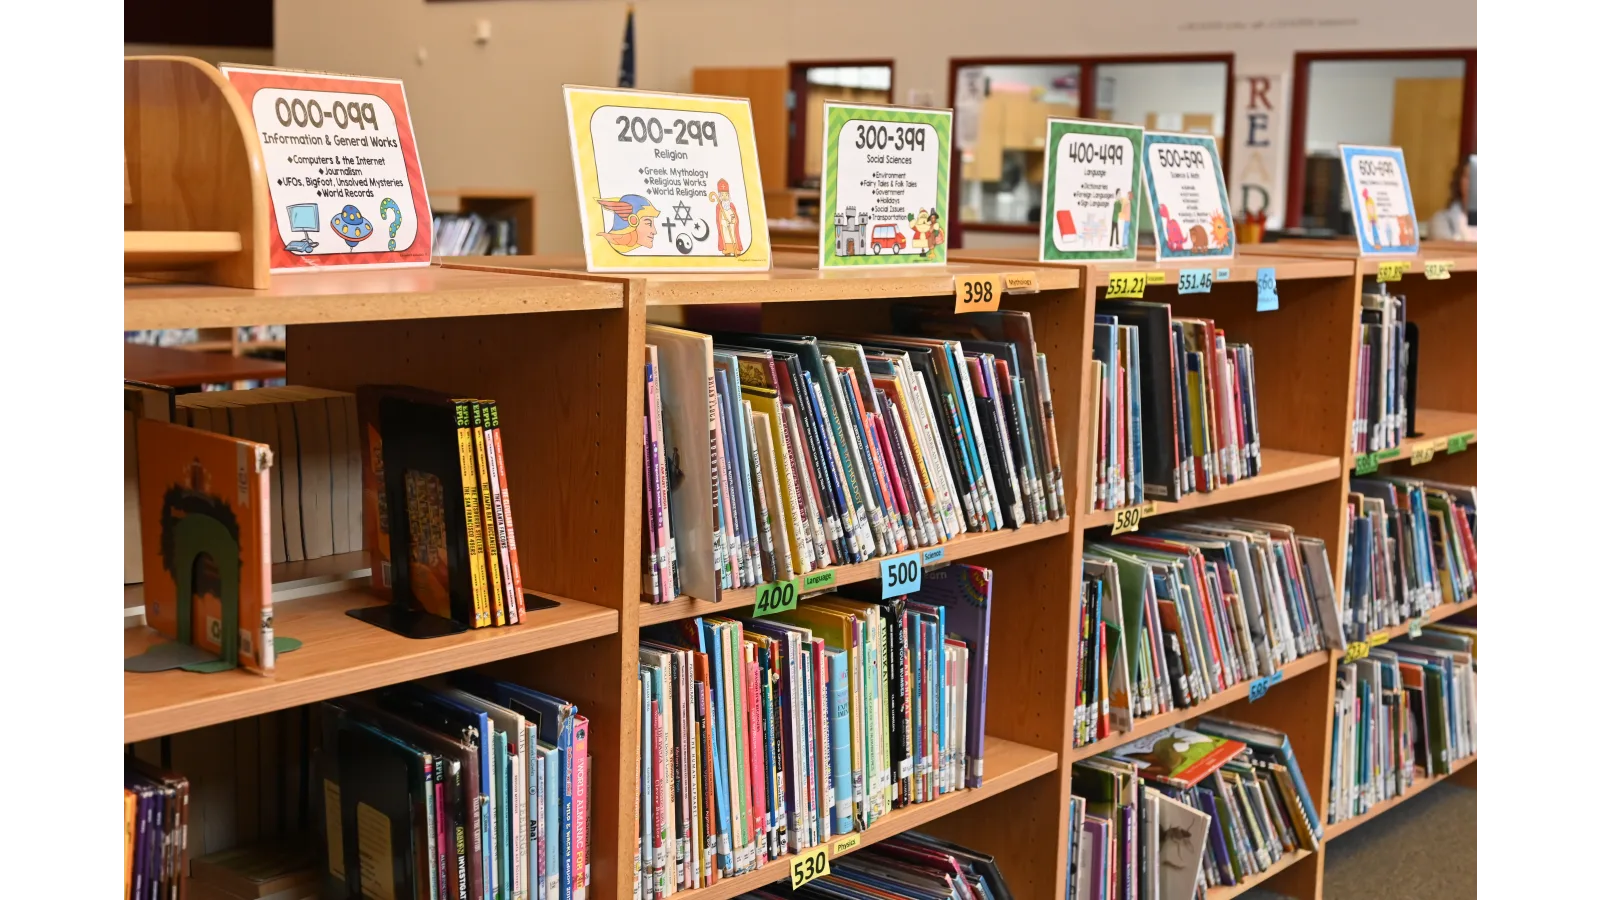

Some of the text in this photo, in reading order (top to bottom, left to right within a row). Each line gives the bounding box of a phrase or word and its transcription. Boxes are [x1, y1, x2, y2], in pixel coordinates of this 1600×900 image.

[275, 97, 379, 131] 000-099
[616, 116, 717, 147] 200-299
[856, 125, 925, 151] 300-399
[262, 132, 398, 148] Information & General Works
[293, 155, 333, 165] Computers
[342, 156, 354, 165] the
[356, 156, 385, 165] Internet
[654, 149, 688, 161] Religion
[867, 155, 912, 164] Social Sciences
[1070, 142, 1123, 165] 400-499
[1158, 148, 1204, 169] 500-599
[325, 167, 362, 176] Journalism
[644, 167, 708, 178] Greek Mythology
[283, 178, 403, 189] UFOs, Bigfoot, Unsolved Mysteries
[650, 177, 706, 187] Religious Works
[322, 189, 374, 198] World Records
[676, 188, 707, 198] Religions
[1108, 277, 1144, 294] 551.21
[1179, 273, 1212, 290] 551.46
[964, 281, 993, 303] 398
[1116, 508, 1138, 530] 580
[925, 550, 941, 560] Science
[806, 573, 832, 585] Language
[888, 560, 917, 587] 500
[758, 584, 794, 612] 400
[838, 839, 856, 851] Physics
[795, 852, 825, 885] 530
